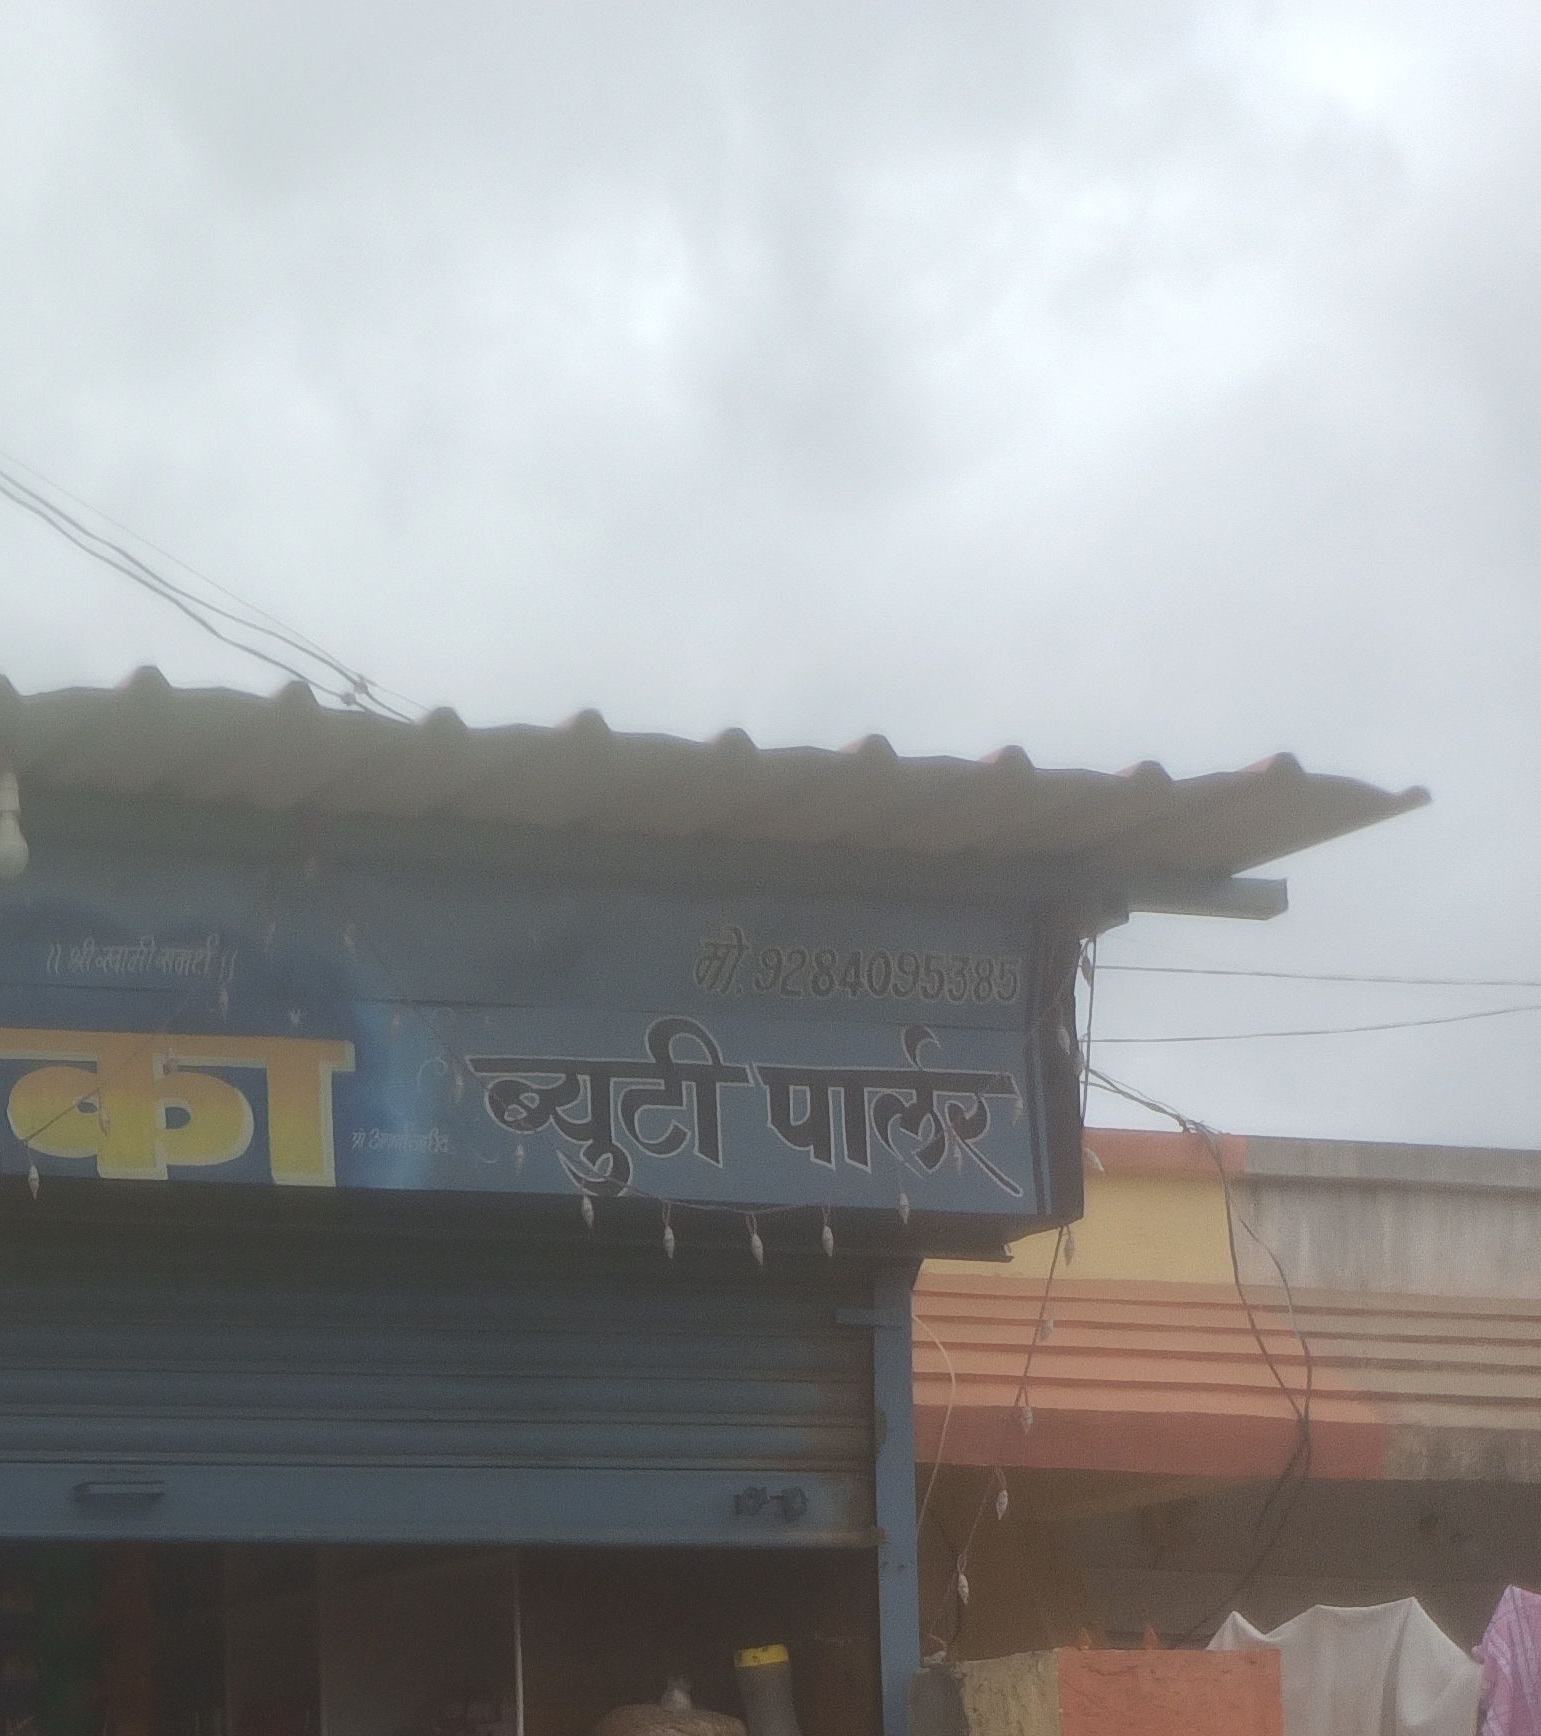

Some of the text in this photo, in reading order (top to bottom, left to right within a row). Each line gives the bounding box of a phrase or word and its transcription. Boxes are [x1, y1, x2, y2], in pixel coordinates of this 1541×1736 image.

[753, 946, 1020, 1002] 9284095385
[463, 1016, 757, 1198] ब्युटी
[750, 1023, 1024, 1197] पार्लर
